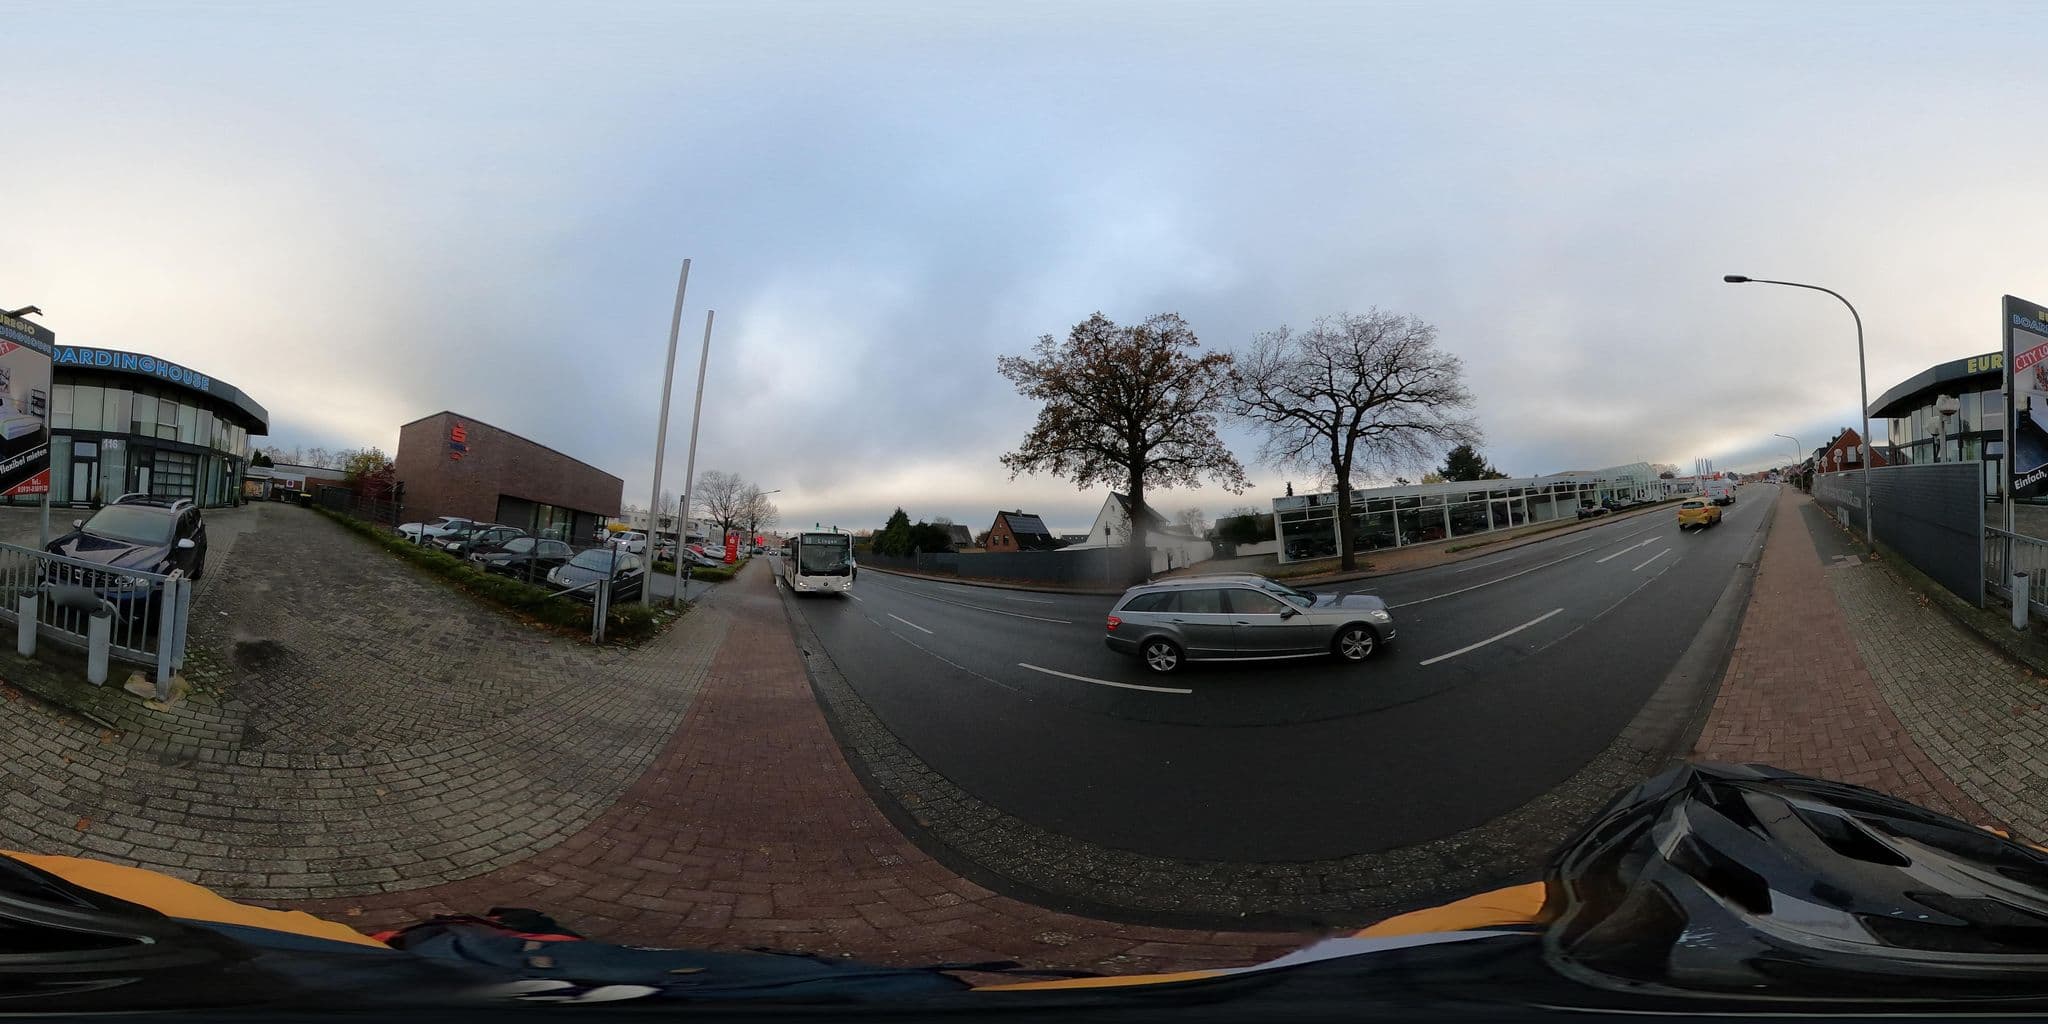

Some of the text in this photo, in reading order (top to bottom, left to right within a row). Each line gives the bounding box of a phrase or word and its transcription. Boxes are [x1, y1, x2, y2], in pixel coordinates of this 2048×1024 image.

[2016, 350, 2038, 370] CITY
[26, 448, 48, 462] mieten
[2014, 469, 2047, 490] Einfach,
